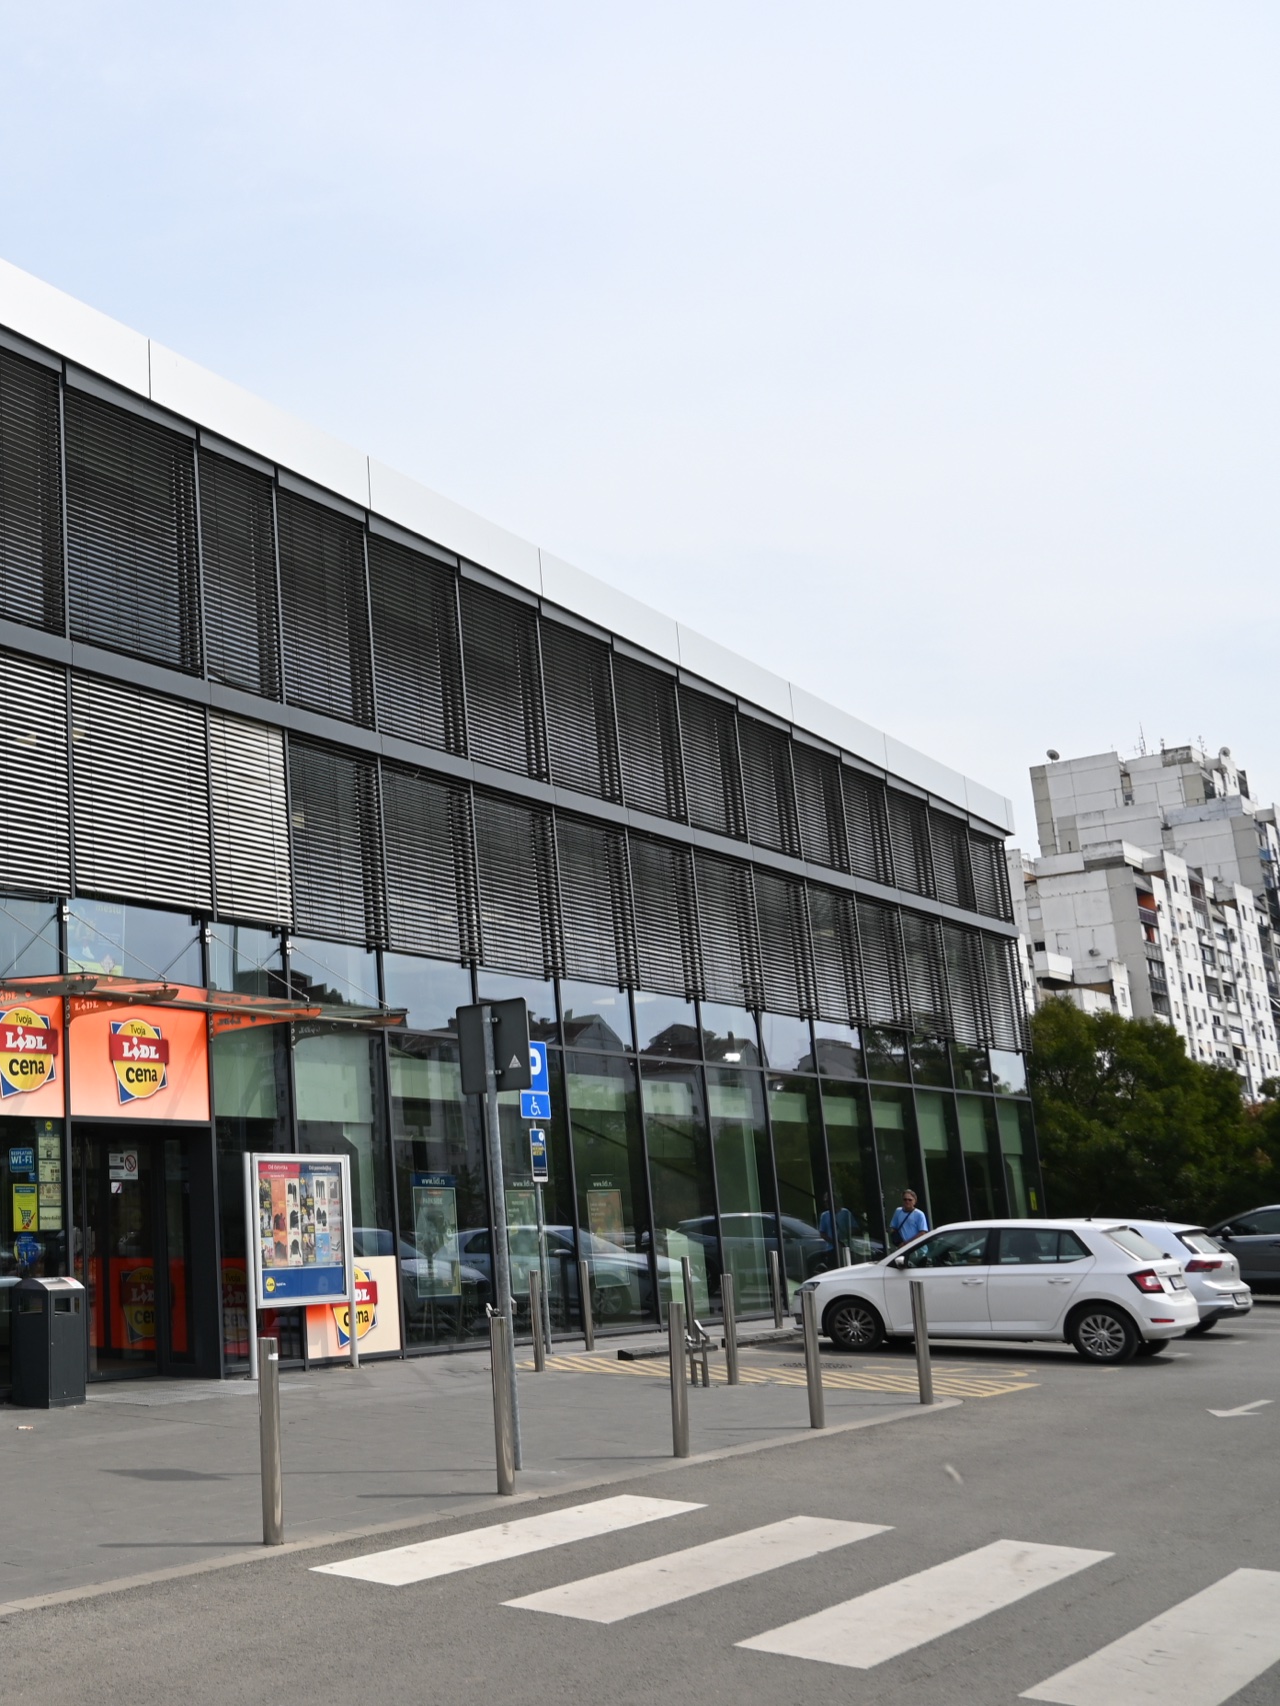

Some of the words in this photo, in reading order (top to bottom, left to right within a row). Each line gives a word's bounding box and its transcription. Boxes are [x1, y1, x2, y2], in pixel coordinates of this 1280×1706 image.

[15, 1012, 32, 1026] Tvoja
[130, 1024, 146, 1037] Tvoja
[8, 1059, 45, 1076] cena
[125, 1067, 157, 1083] cena
[355, 1288, 370, 1302] DL
